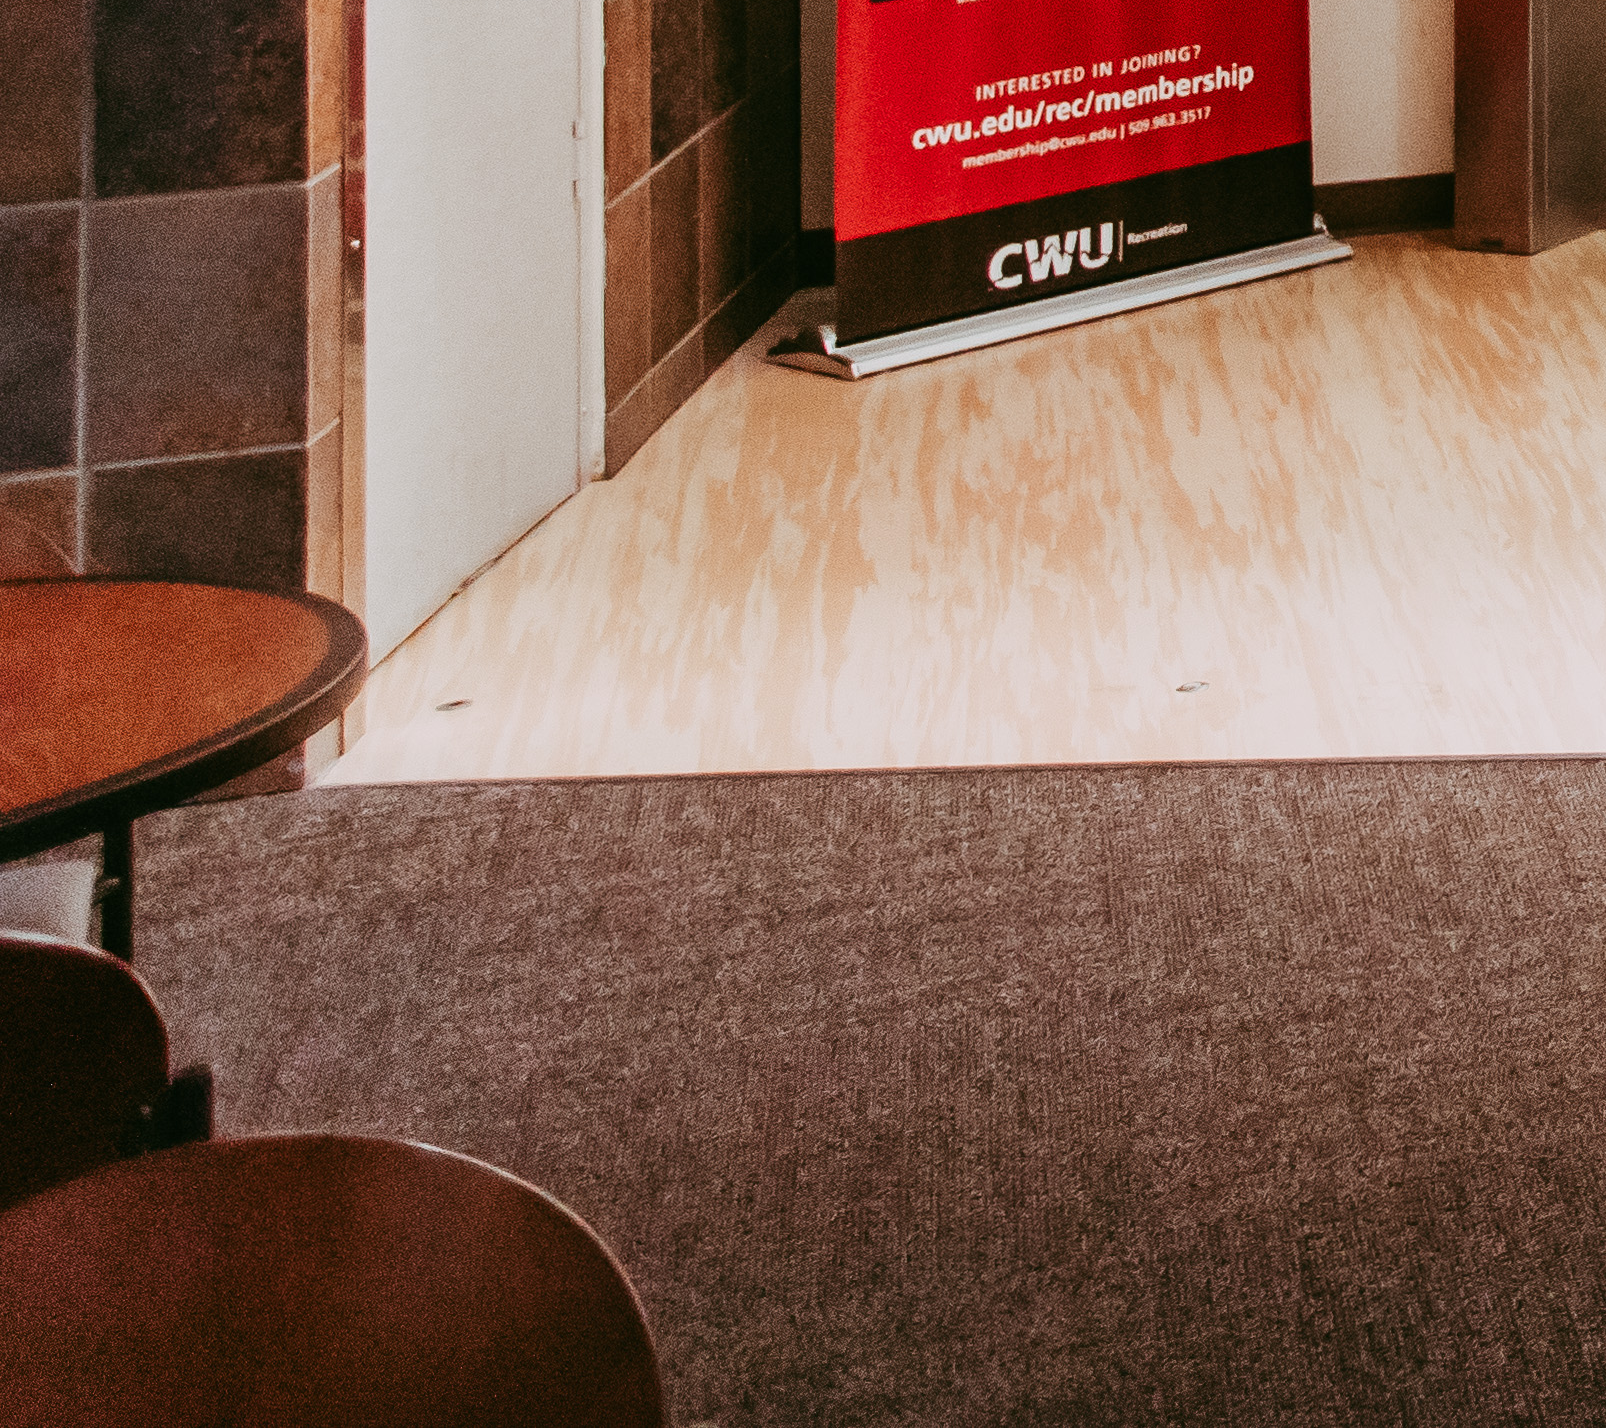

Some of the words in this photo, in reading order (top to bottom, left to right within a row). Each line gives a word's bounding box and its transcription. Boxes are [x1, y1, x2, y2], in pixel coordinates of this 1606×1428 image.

[975, 66, 1085, 102] INTERESTED
[1092, 61, 1114, 78] IN
[1120, 43, 1202, 75] JOINING?
[911, 63, 1255, 150] cwu.edu/rec/membership
[962, 127, 1118, 170] membership@cwu.edu
[1128, 106, 1212, 137] 509.963.3517
[988, 222, 1114, 290] CWU
[1126, 222, 1188, 246] Recreation
